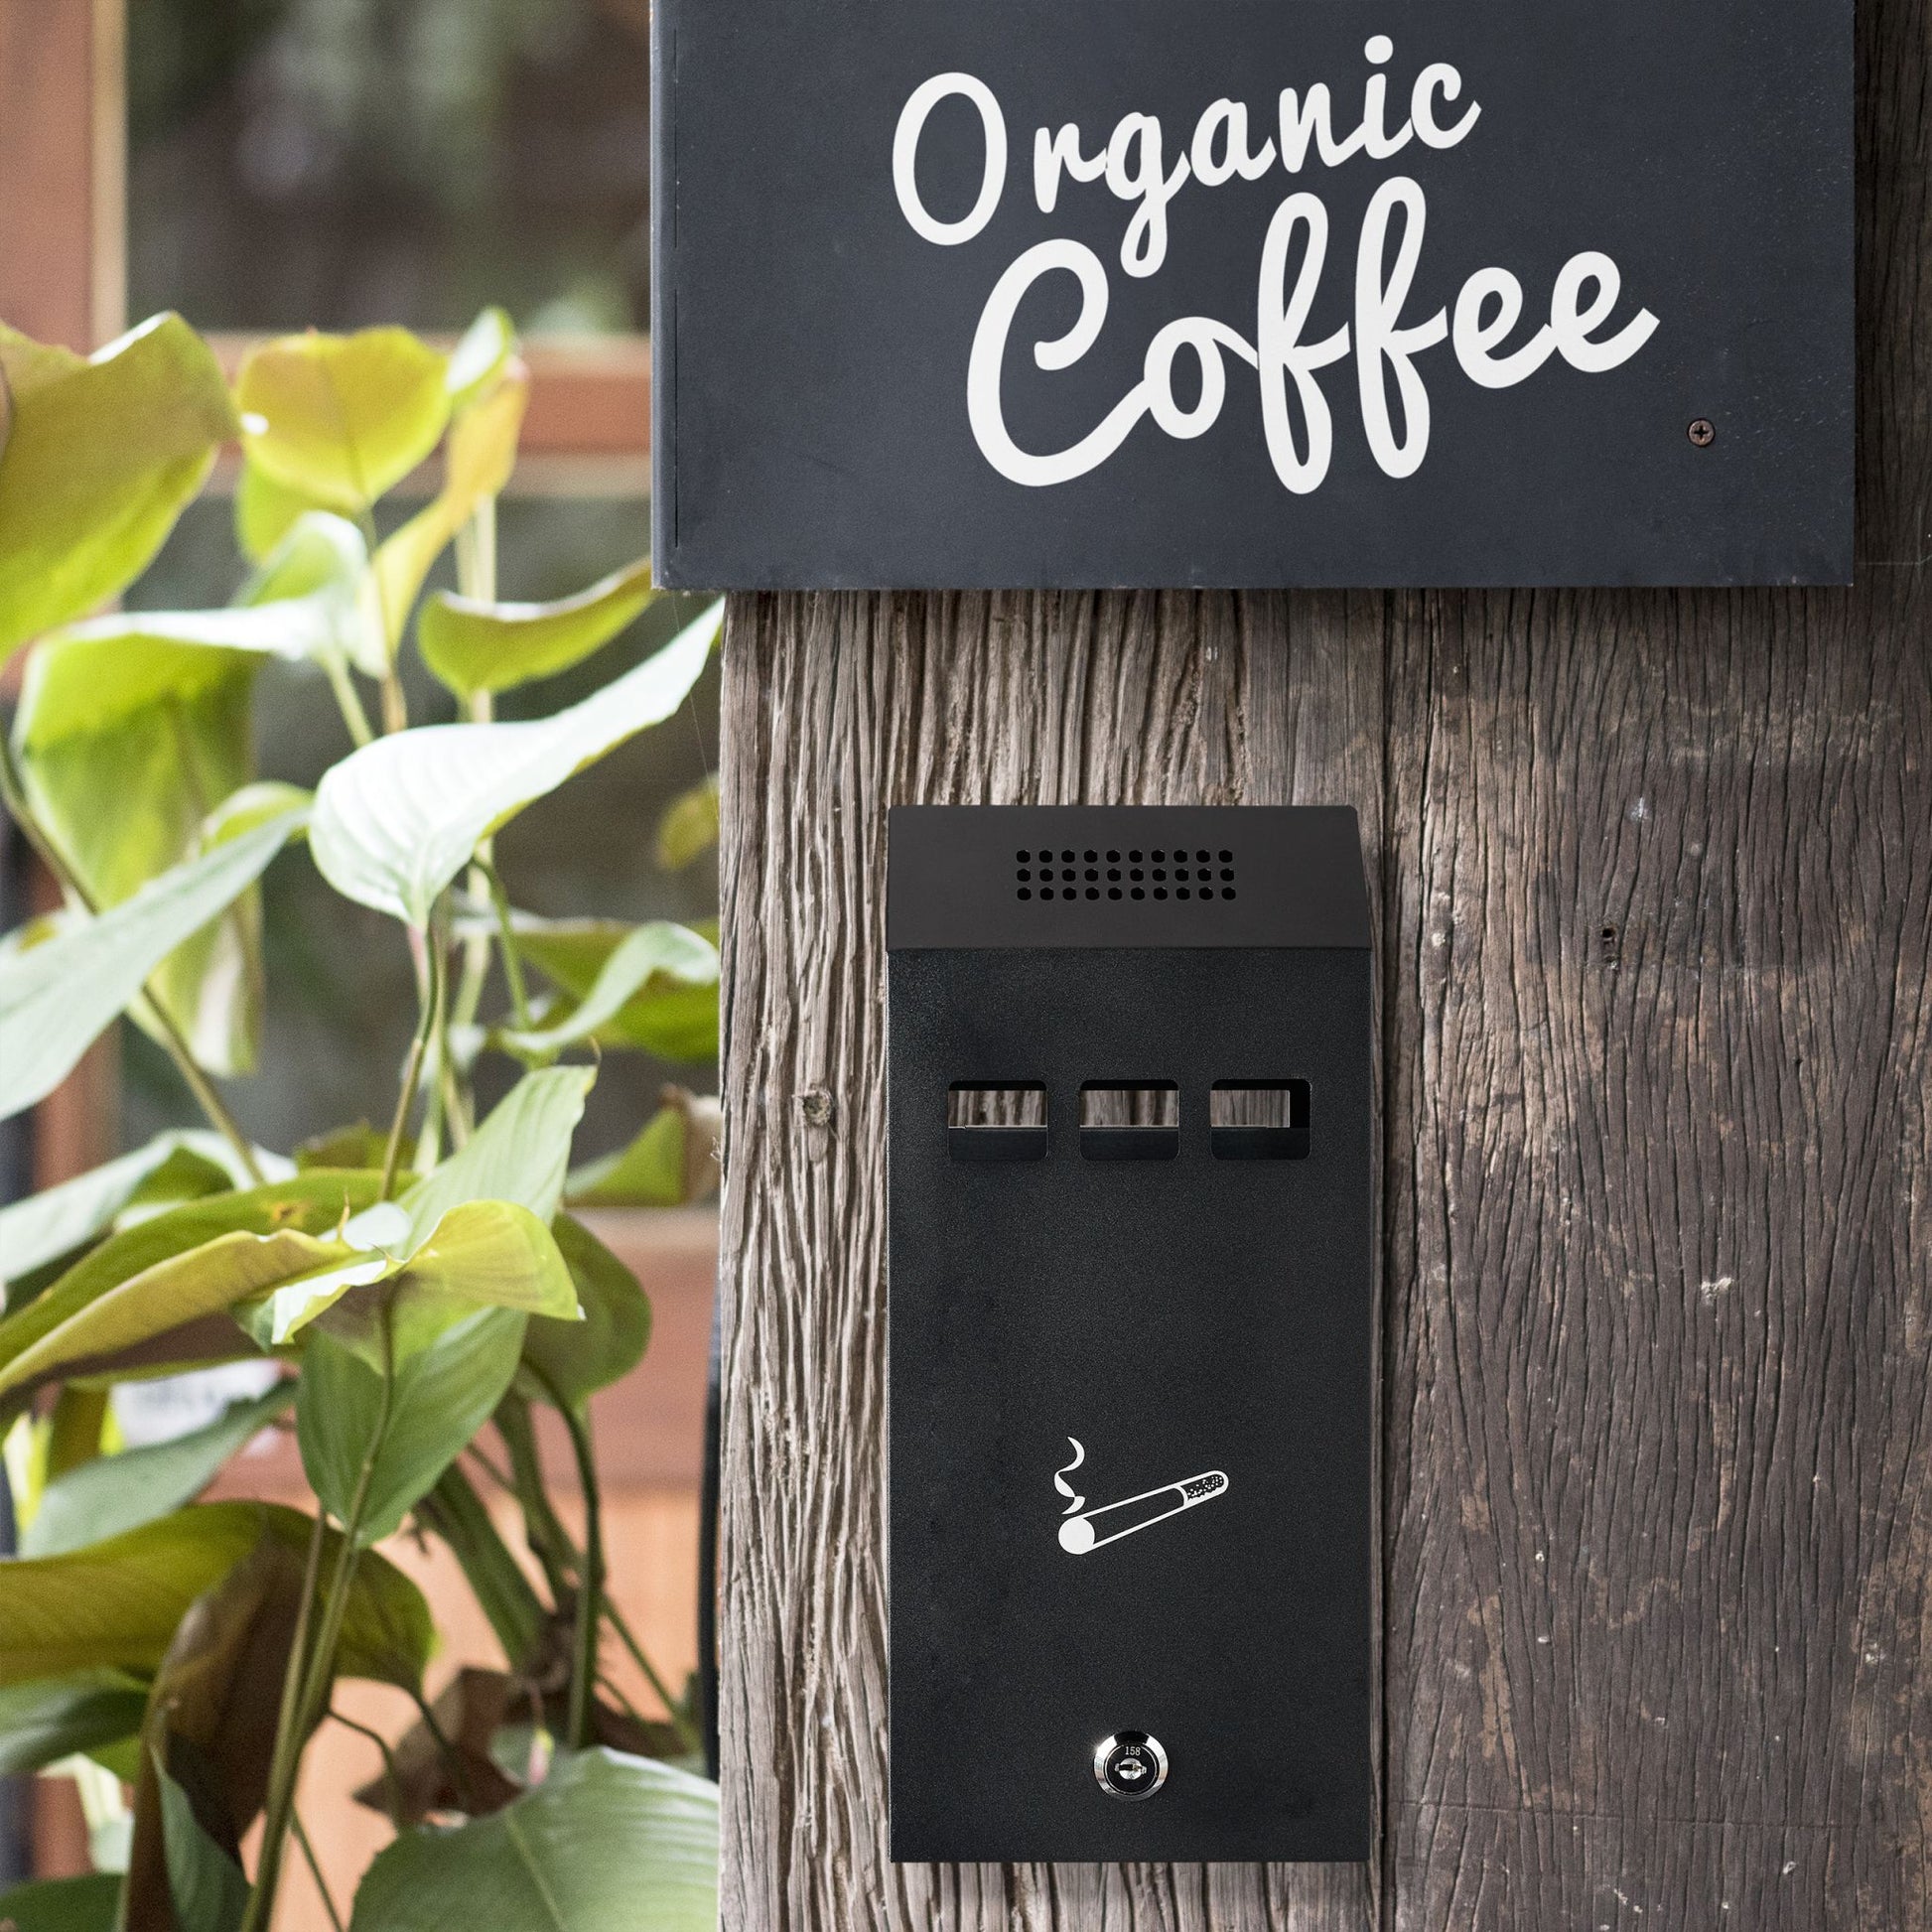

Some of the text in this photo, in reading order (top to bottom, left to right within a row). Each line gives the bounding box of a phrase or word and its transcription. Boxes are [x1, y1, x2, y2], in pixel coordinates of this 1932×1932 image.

[892, 35, 1481, 277] Organic
[967, 177, 1661, 494] Coffee
[1125, 1746, 1141, 1756] 158
